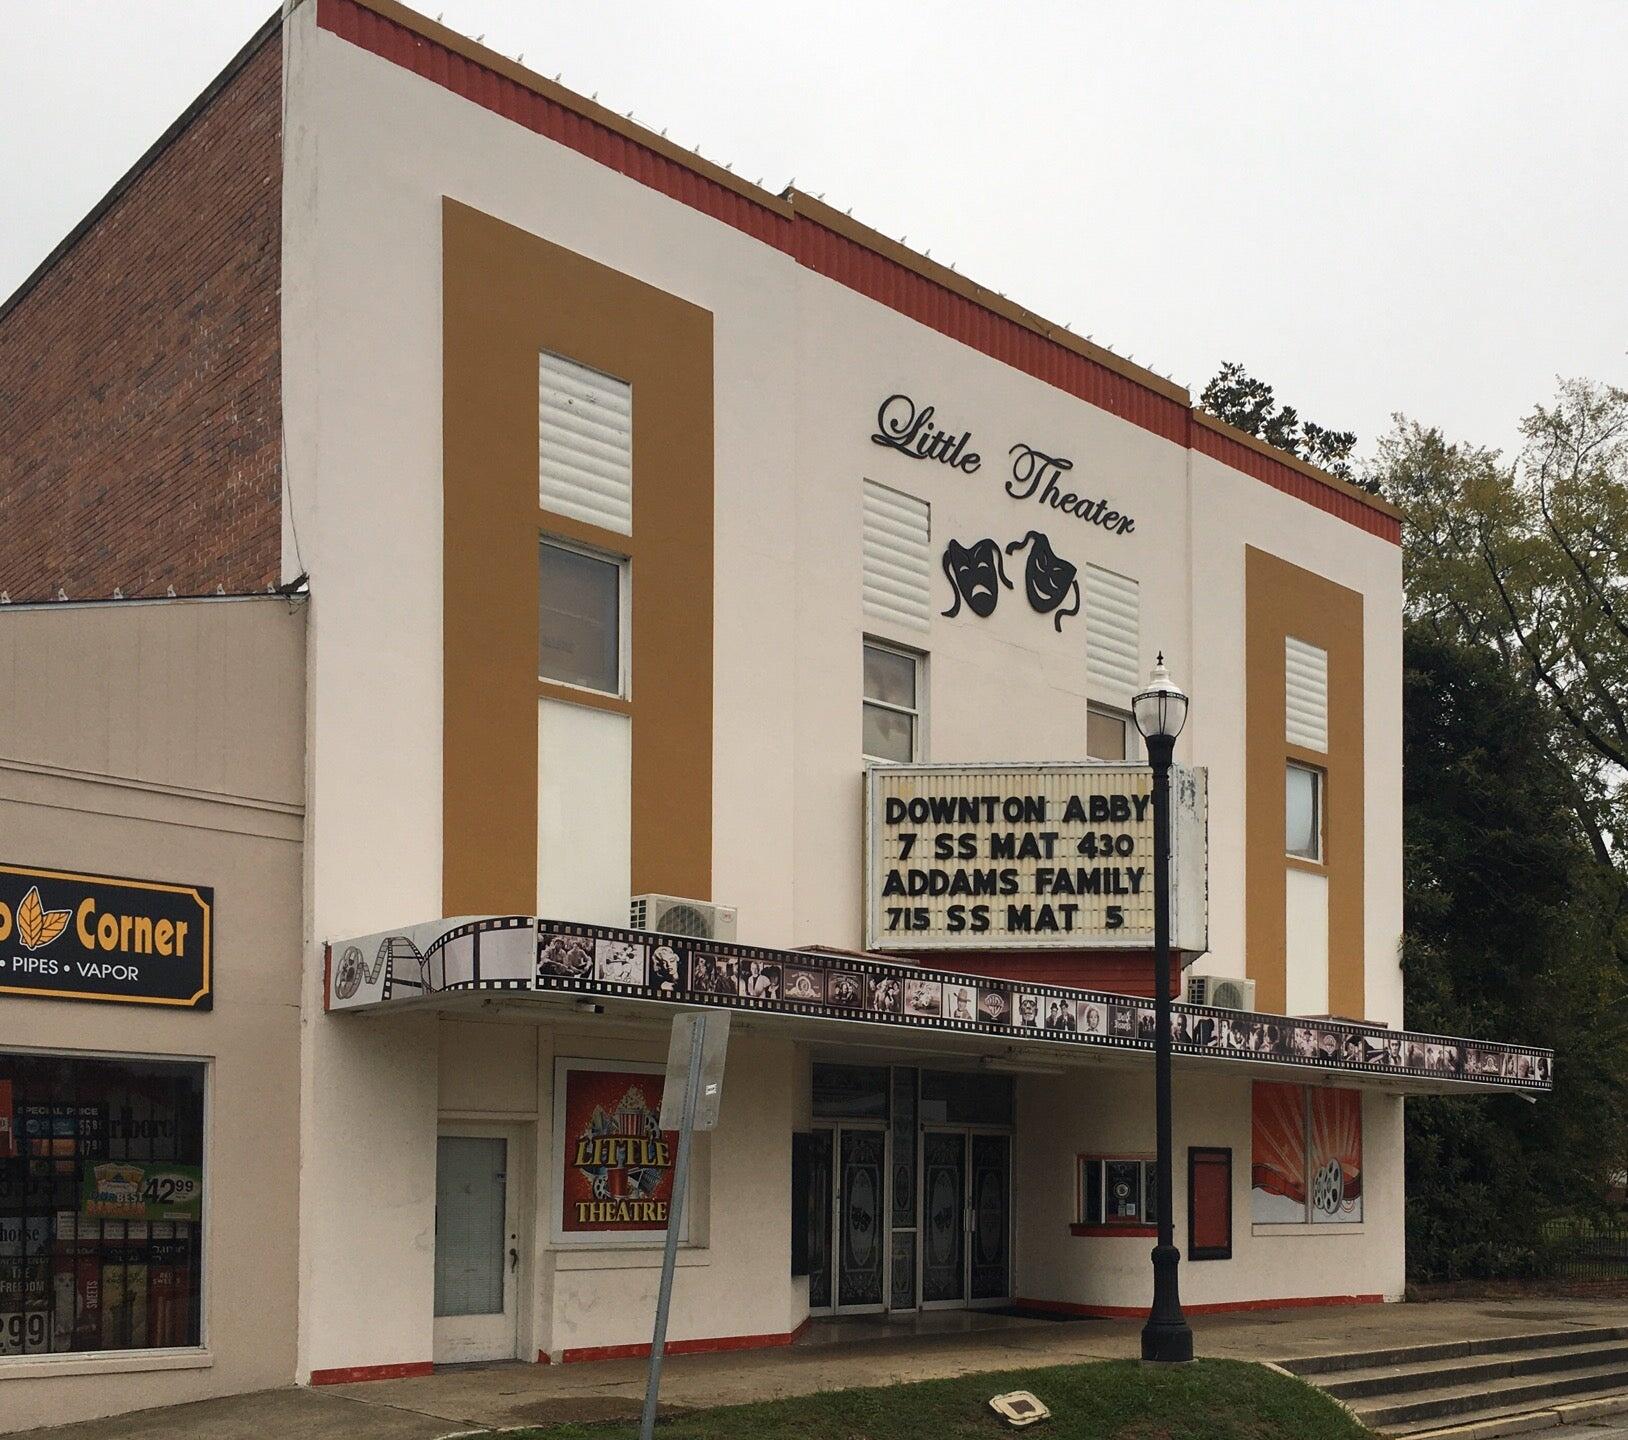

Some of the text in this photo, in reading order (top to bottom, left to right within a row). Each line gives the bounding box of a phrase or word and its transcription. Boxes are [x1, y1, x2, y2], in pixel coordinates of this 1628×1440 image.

[870, 394, 982, 474] Little
[1005, 443, 1135, 535] Theater
[885, 794, 1150, 824] DOWNTON ABBY
[898, 831, 1134, 860] 7 SS MAT 430
[882, 867, 1145, 896] ADDAMS FAMILY
[76, 897, 188, 957] Corner
[887, 904, 1124, 931] 715 SS MAT 5
[12, 957, 140, 981] PIPES VAPOR
[574, 1137, 672, 1167] LITTLE
[576, 1202, 668, 1223] THEATRE
